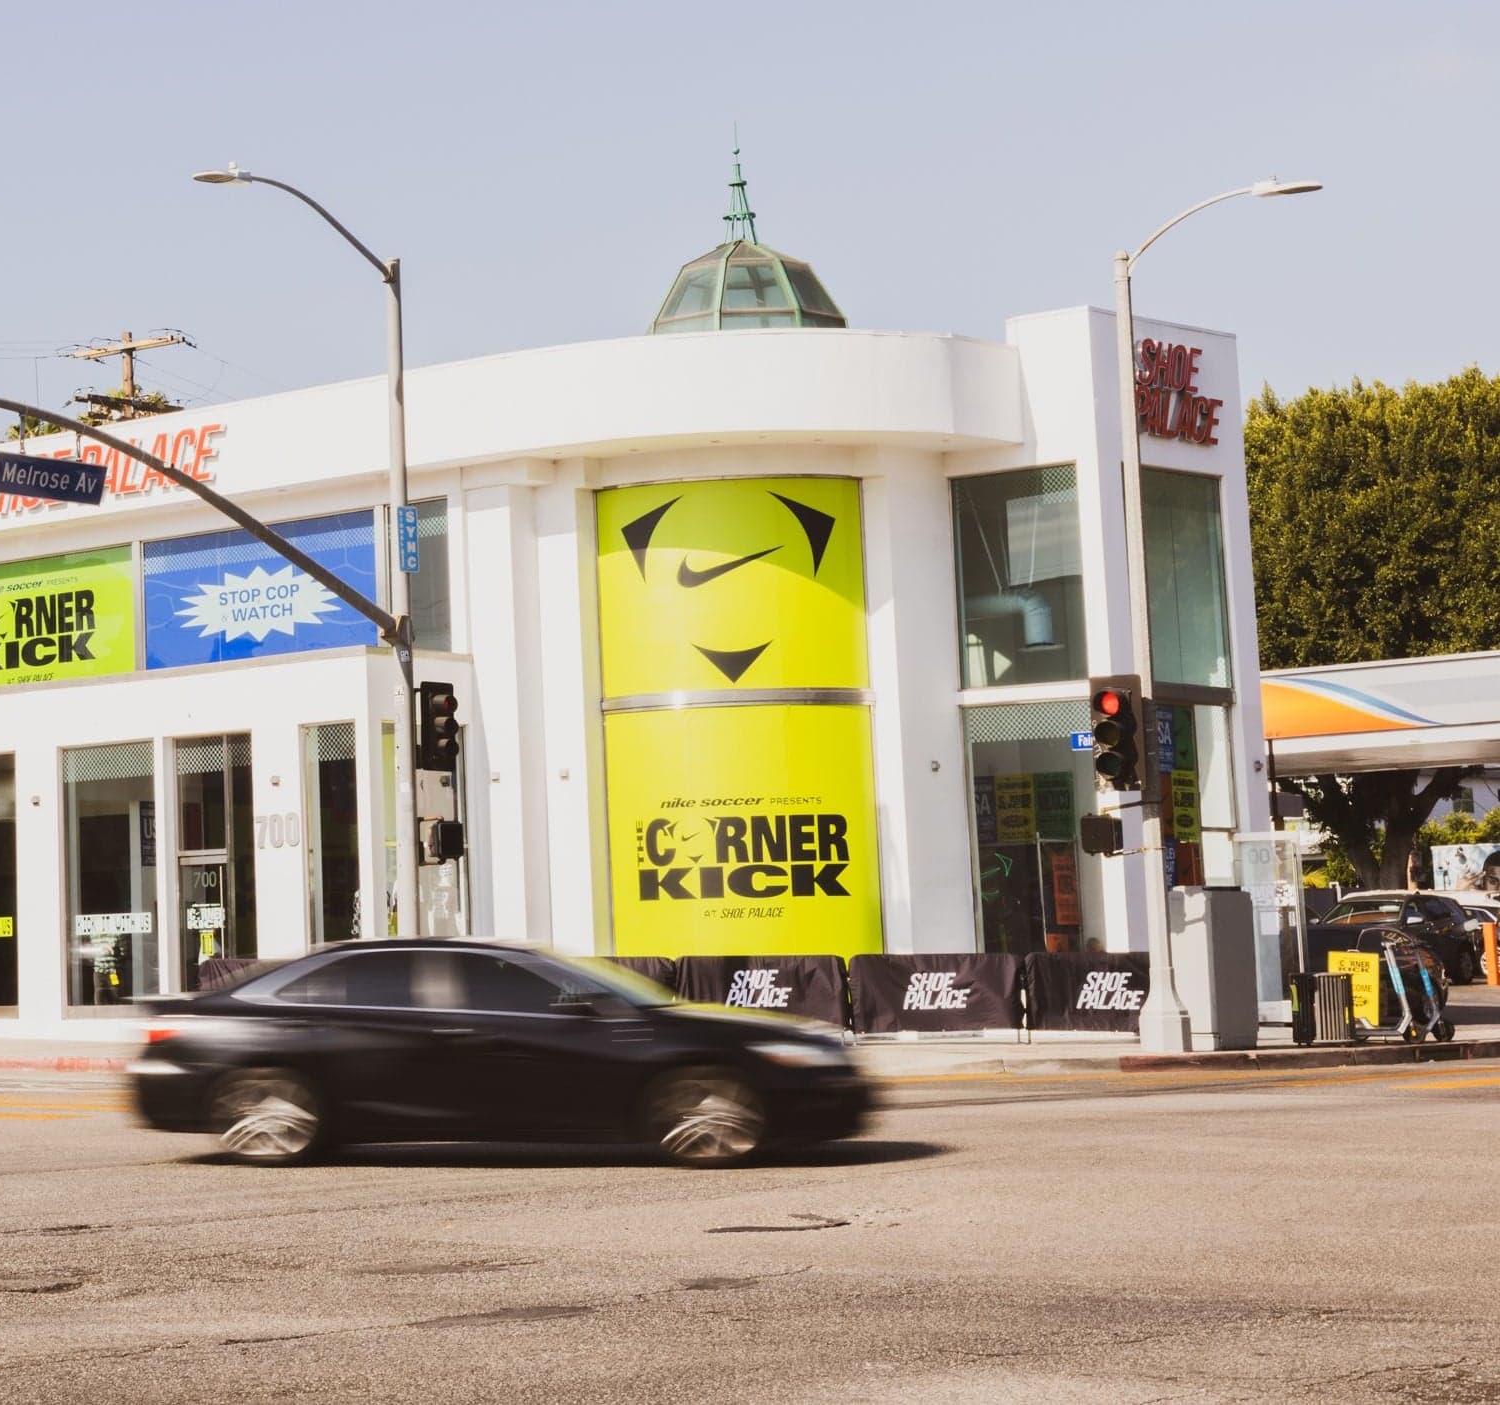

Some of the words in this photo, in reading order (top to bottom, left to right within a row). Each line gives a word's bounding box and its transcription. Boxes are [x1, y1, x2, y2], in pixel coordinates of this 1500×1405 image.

[1137, 338, 1203, 393] SHOE
[1136, 384, 1223, 446] PALACE
[2, 461, 70, 491] Melrose
[74, 472, 97, 495] Av
[5, 580, 43, 592] soccer
[266, 583, 300, 600] COP
[232, 602, 293, 622] WATCH
[660, 797, 696, 809] nike
[700, 797, 764, 808] soccer
[770, 796, 822, 806] PRESENTS
[255, 812, 301, 850] 700
[646, 814, 850, 867] CRNER
[194, 871, 217, 888] 700
[638, 863, 852, 902] KICK
[720, 907, 746, 919] SHOE
[748, 906, 785, 919] PALACE
[731, 969, 779, 989] SHOE
[908, 972, 956, 991] SHOE
[1083, 971, 1132, 991] SHOE
[725, 987, 793, 1007] PALACE
[903, 989, 971, 1010] PALACE
[1076, 990, 1144, 1010] PALACE
